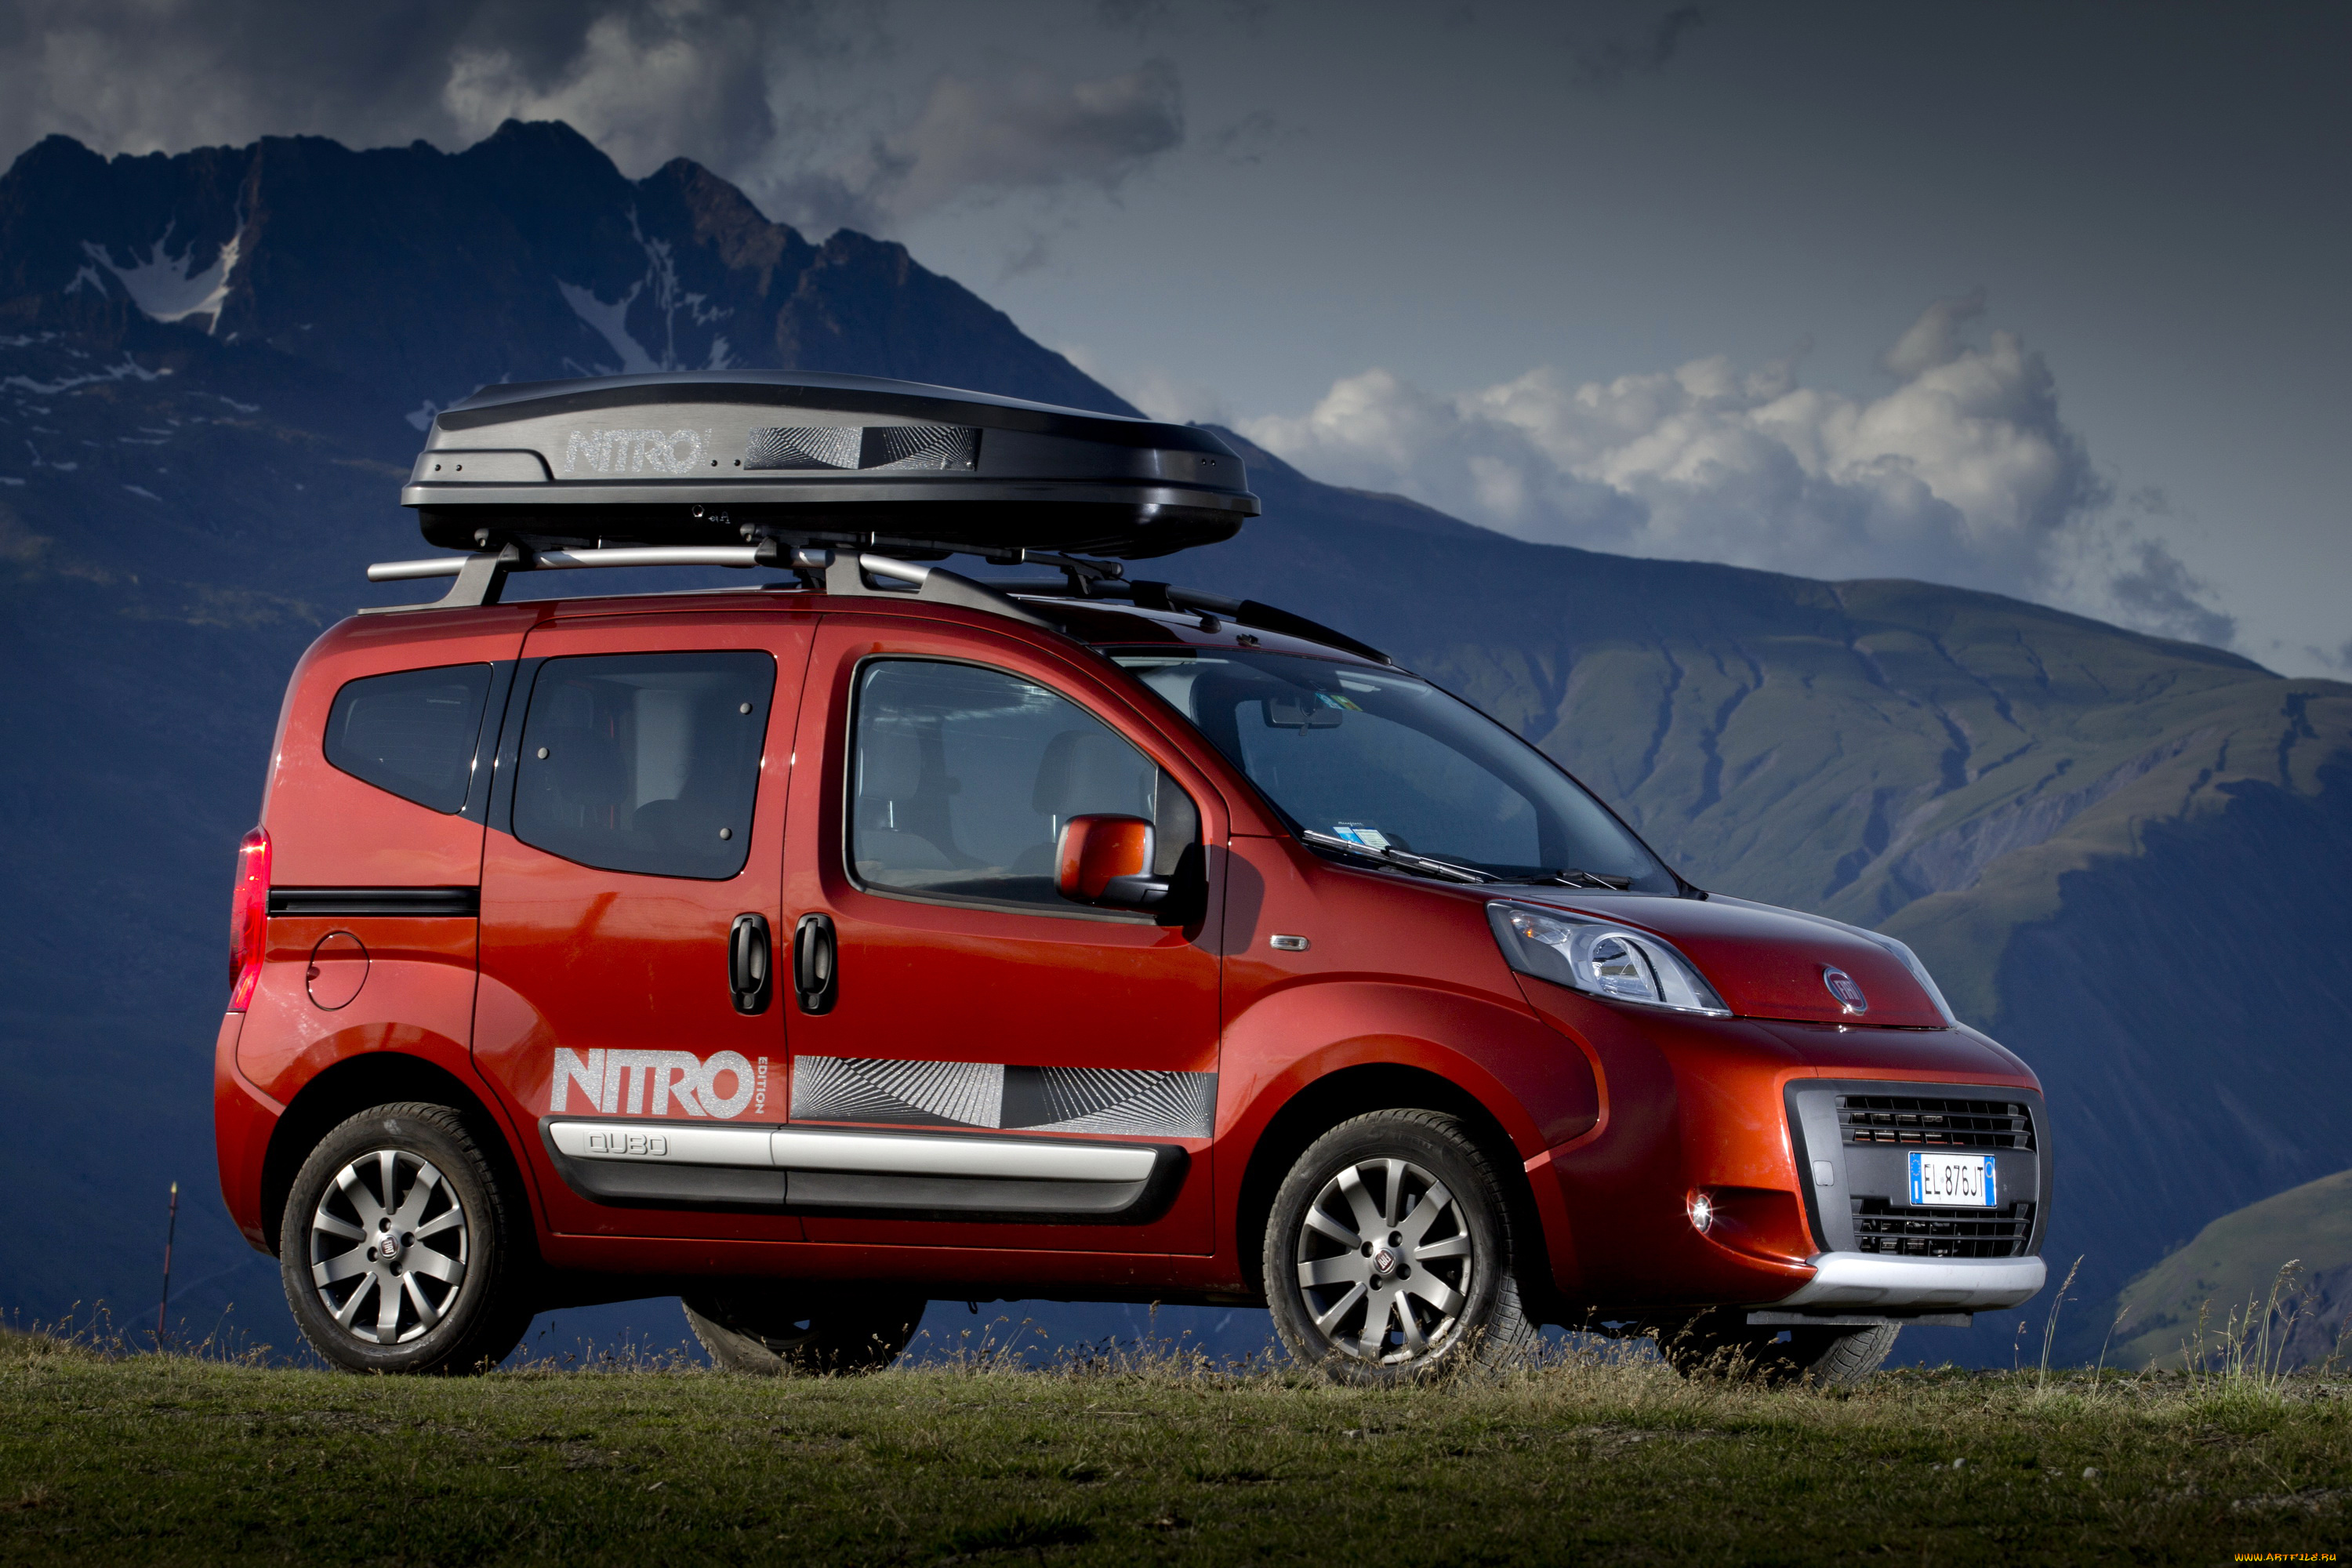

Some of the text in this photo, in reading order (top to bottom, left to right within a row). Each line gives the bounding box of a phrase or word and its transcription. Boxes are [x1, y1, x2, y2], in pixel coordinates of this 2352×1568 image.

[564, 429, 702, 474] NITRO
[1833, 980, 1860, 1000] FIAT
[550, 1047, 755, 1119] NITRO
[754, 1056, 768, 1114] EDITION
[589, 1132, 668, 1156] QUBO
[1924, 1164, 1984, 1197] EL 876JT
[383, 1240, 395, 1254] FIAT
[1377, 1253, 1392, 1269] FIAT
